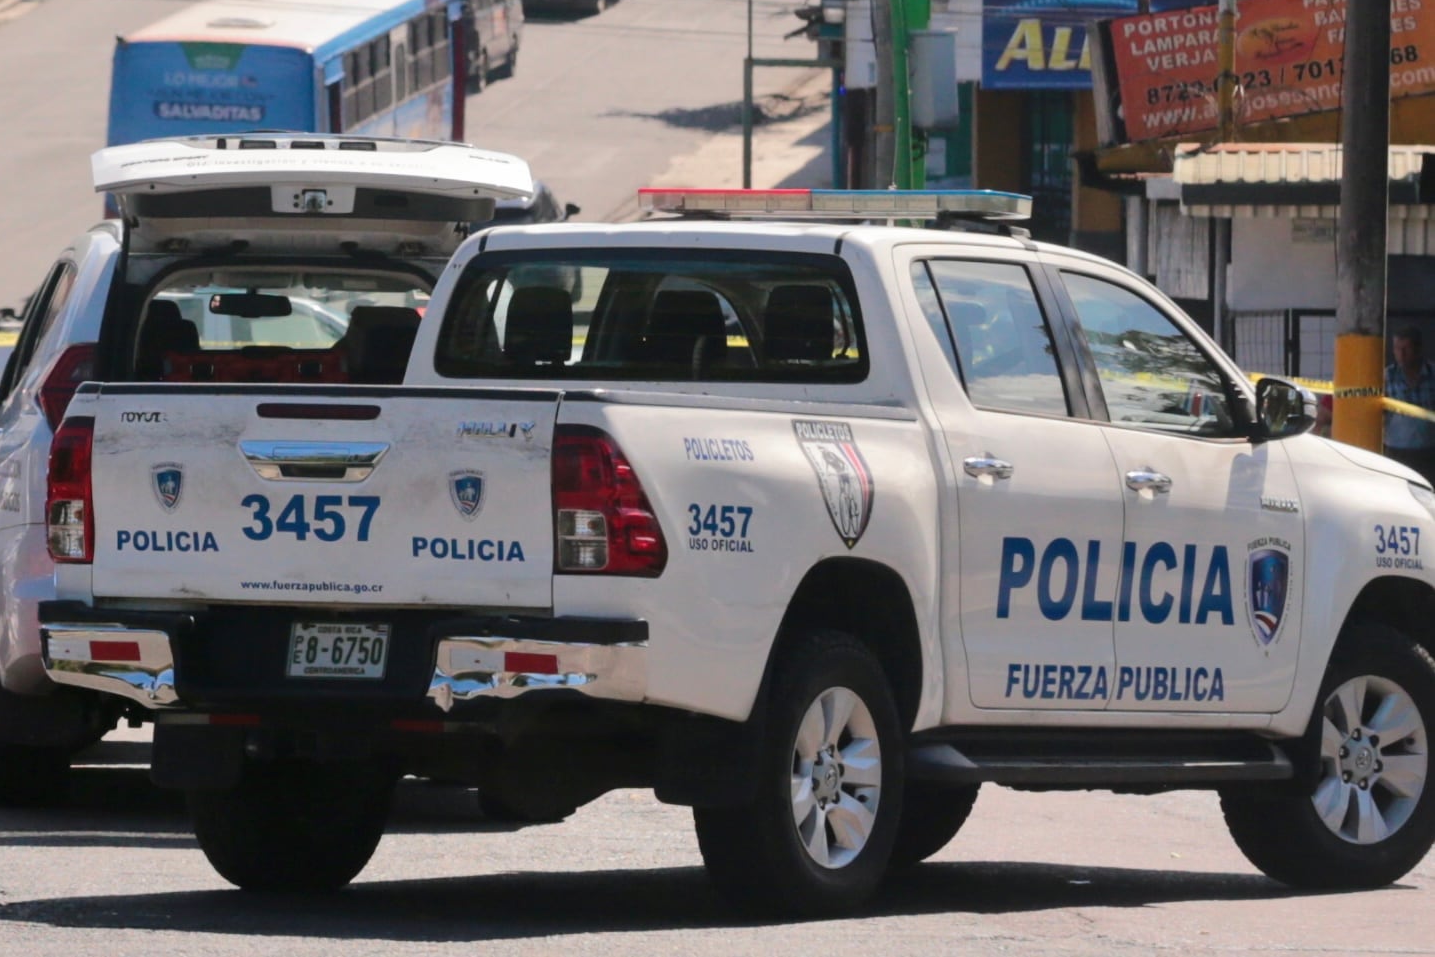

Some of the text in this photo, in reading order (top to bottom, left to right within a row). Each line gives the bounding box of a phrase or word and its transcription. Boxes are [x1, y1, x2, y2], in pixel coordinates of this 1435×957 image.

[1147, 49, 1216, 71] VERJA
[158, 102, 262, 121] SALVADITAS
[795, 421, 852, 441] POLICLETOS
[683, 437, 754, 461] POLICLETOS
[241, 493, 381, 542] 3457
[688, 503, 753, 538] 3457
[117, 530, 219, 552] POLICIA
[412, 536, 526, 562] POLICIA
[689, 538, 755, 553] USO OFICIAL
[1375, 524, 1421, 556] 3457
[1376, 556, 1424, 570] USO OFICIAL
[240, 579, 383, 594] www.fuerzapublica.go.cr
[996, 536, 1235, 626] POLICIA
[306, 635, 384, 665] 8-6750
[303, 666, 366, 675] CENTROAMERICA
[1005, 663, 1225, 702] FUERZA PUBLICA
